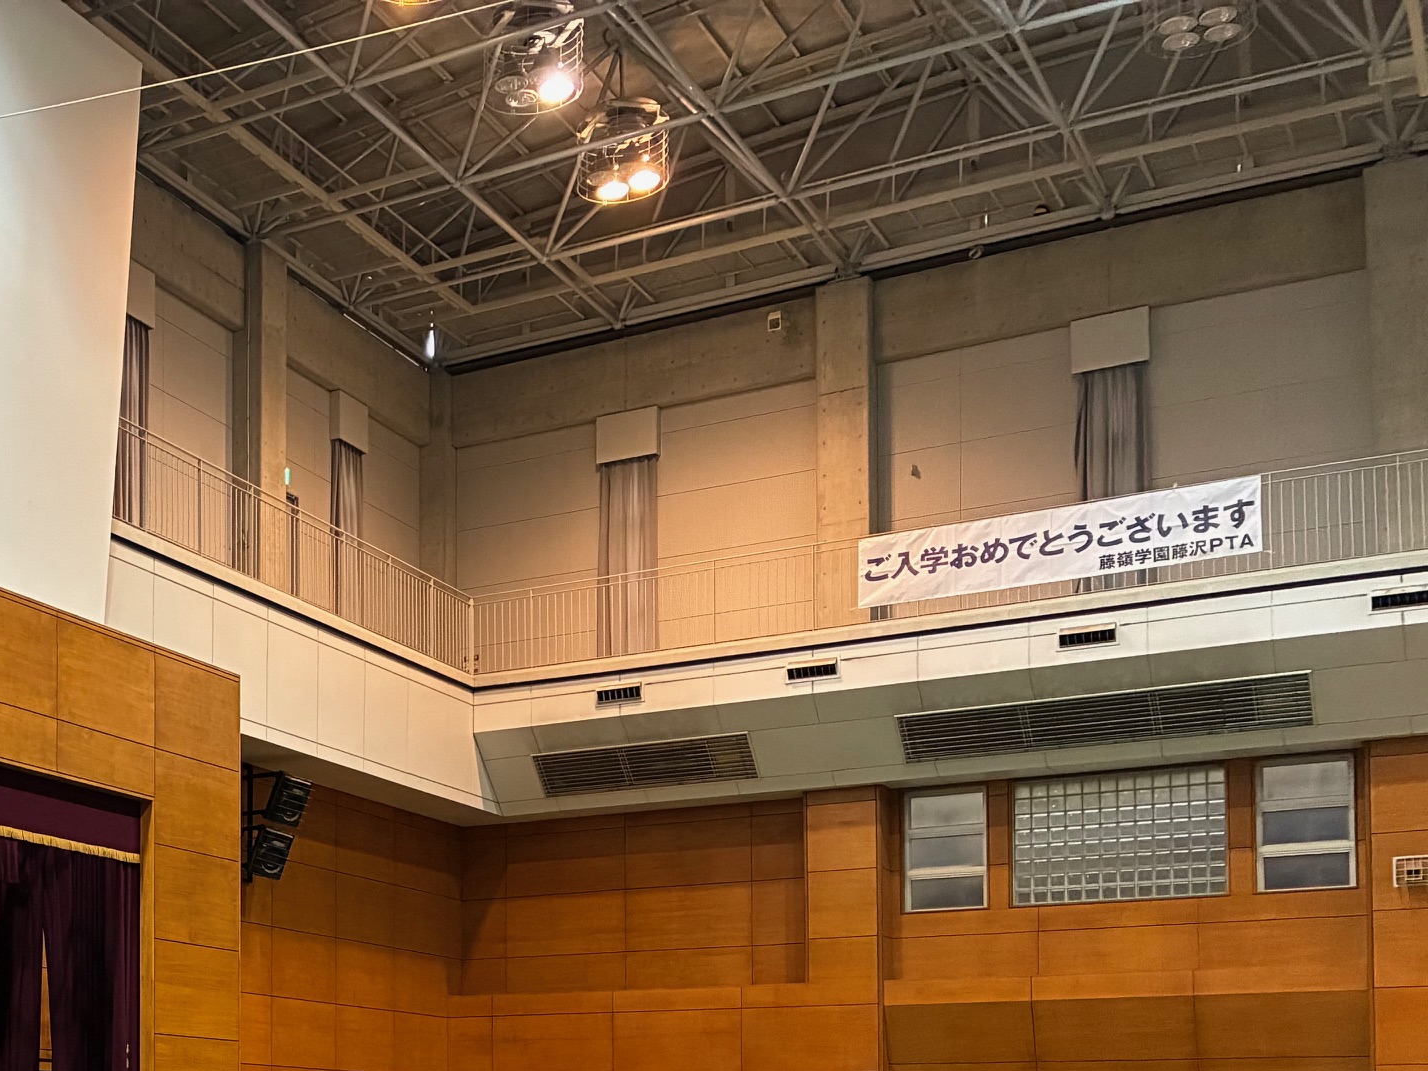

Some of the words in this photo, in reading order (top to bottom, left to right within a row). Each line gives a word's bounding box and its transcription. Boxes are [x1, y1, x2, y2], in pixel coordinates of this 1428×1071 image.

[864, 499, 1255, 582] ご入学おめでとうございます
[1098, 533, 1255, 571] 藤嶺学園藤沢PTA
